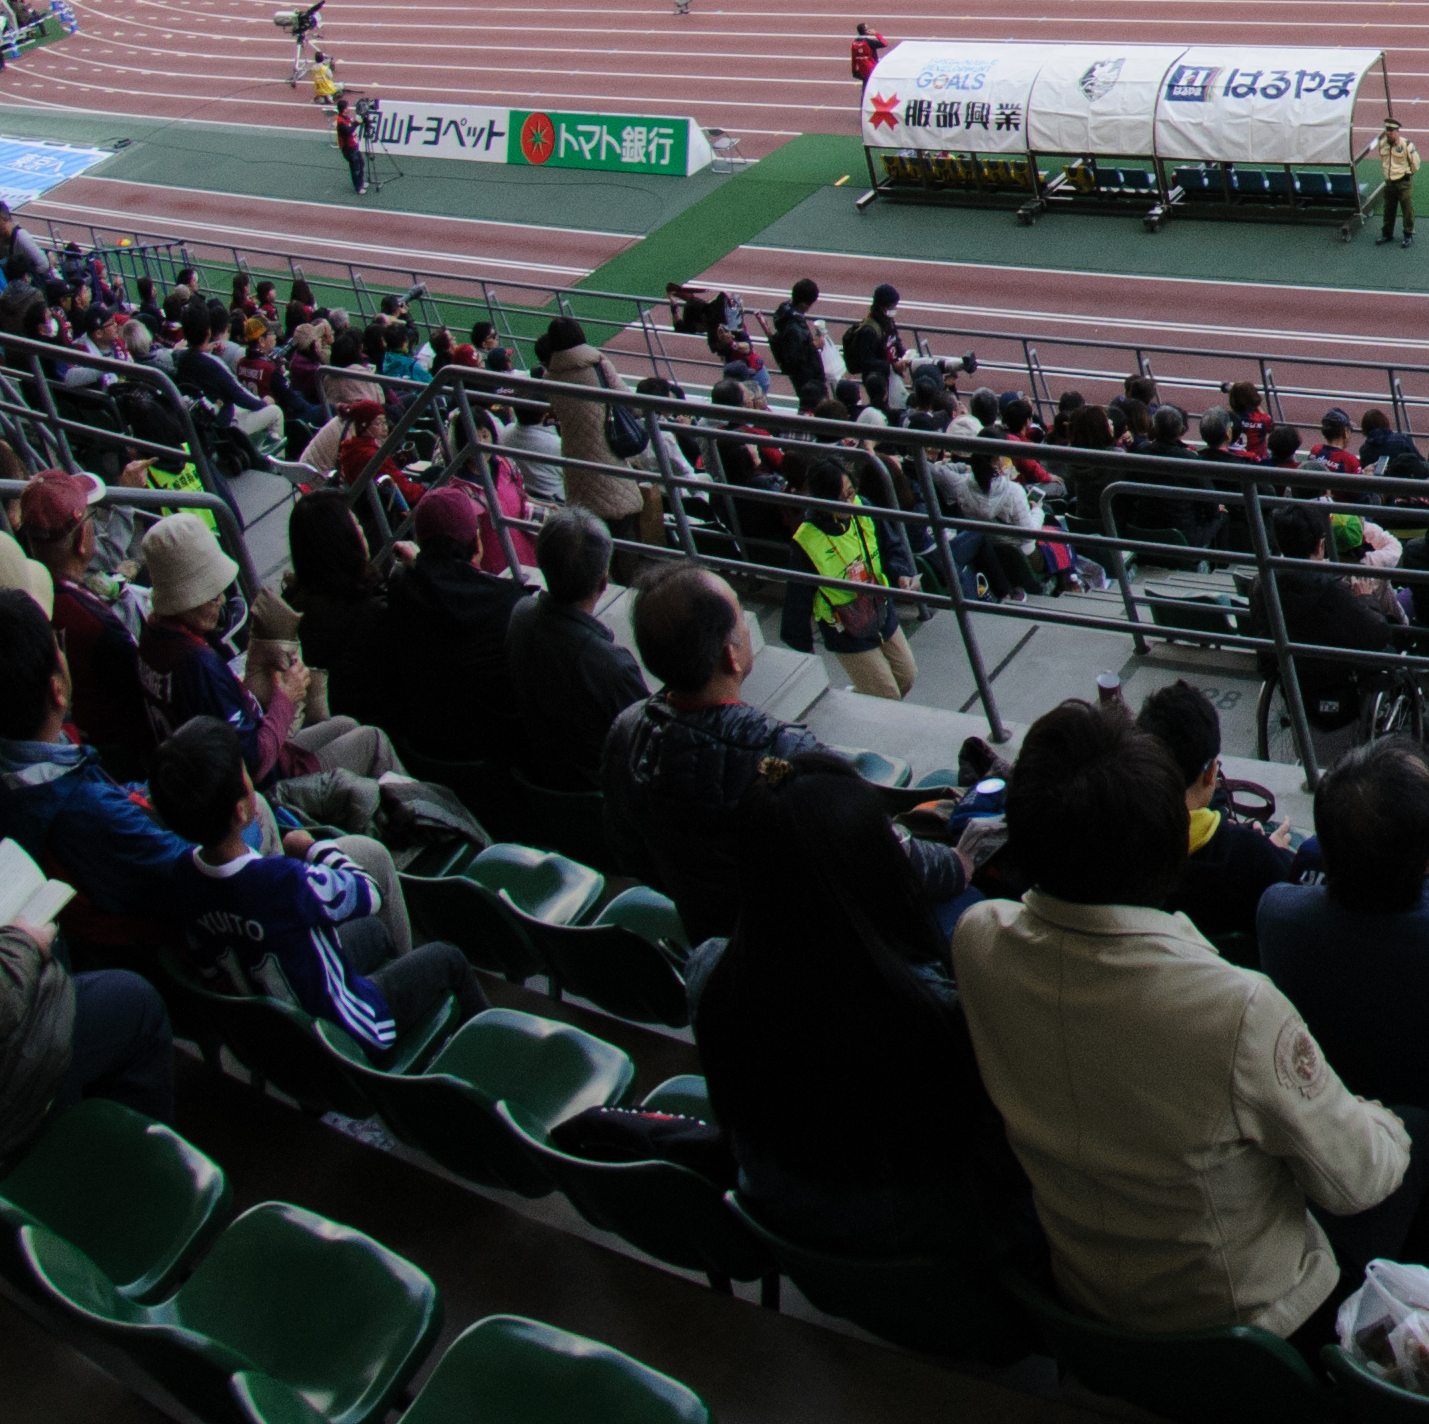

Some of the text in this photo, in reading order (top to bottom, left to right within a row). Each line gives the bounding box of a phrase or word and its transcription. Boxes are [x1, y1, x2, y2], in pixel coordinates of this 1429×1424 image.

[916, 71, 985, 91] GOALS
[1222, 68, 1358, 101] はるやま
[904, 99, 1023, 133] 服部興業
[557, 122, 674, 165] トマト銀行
